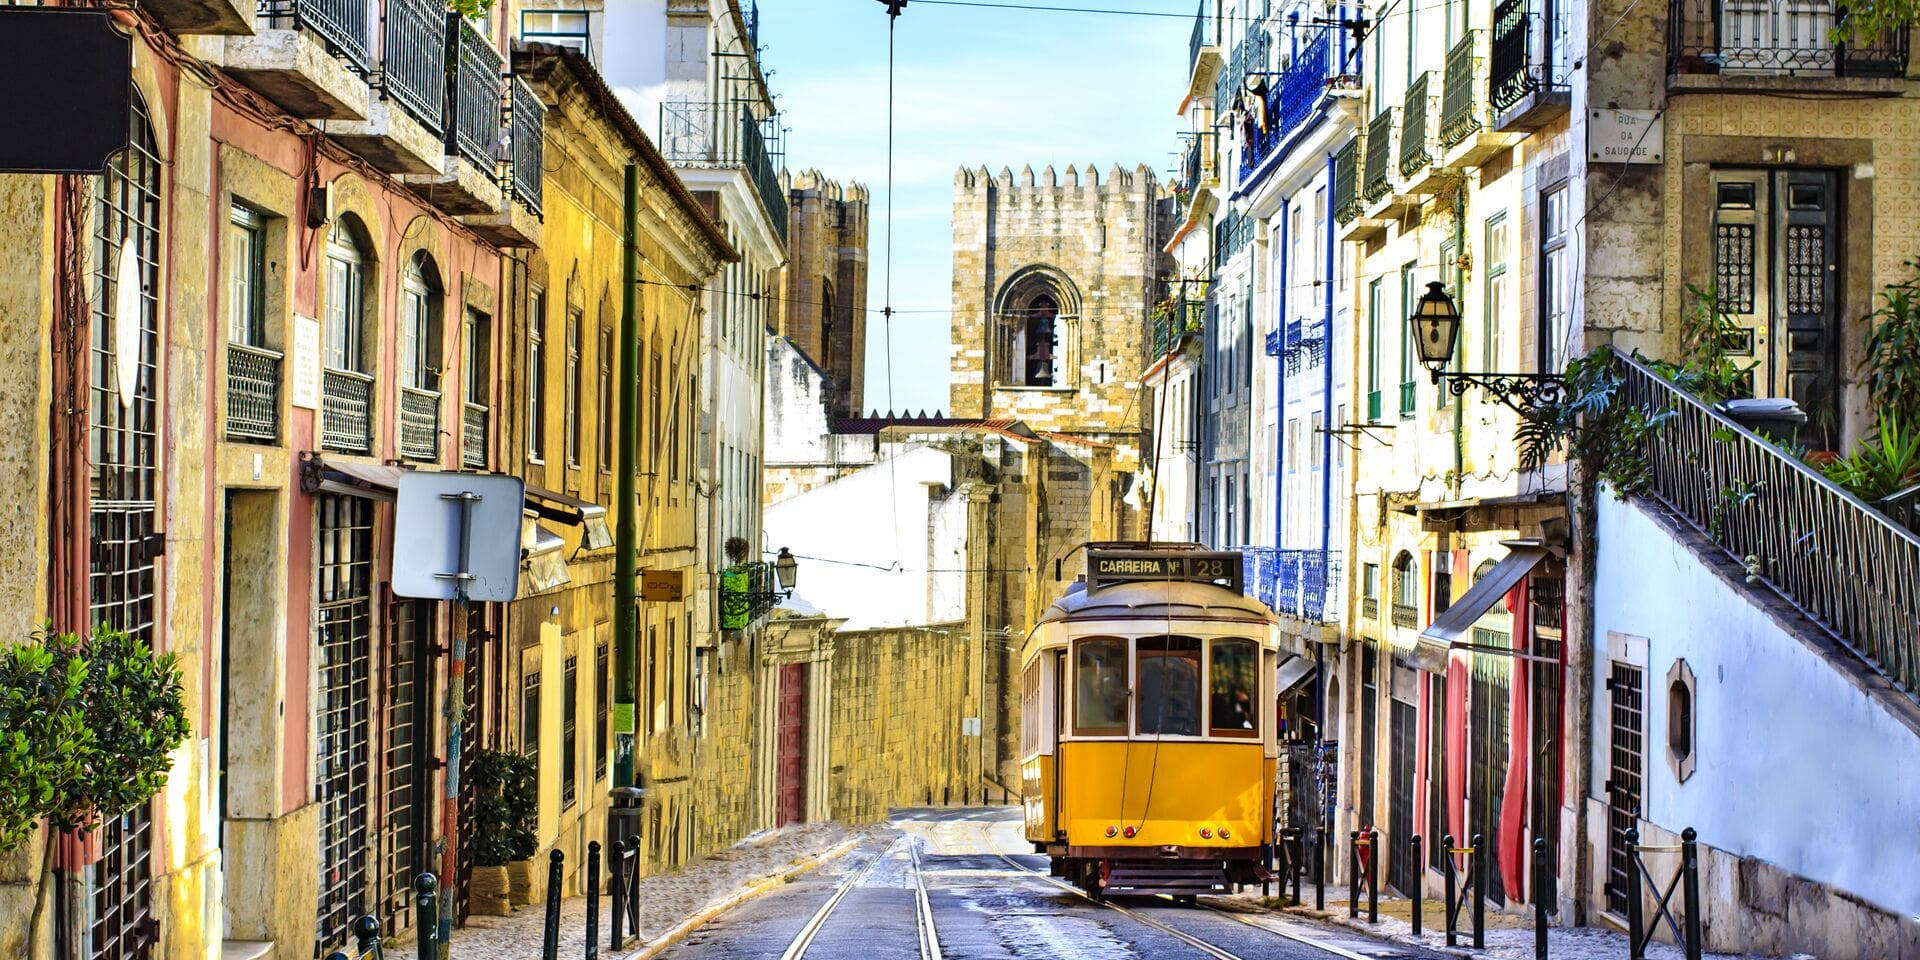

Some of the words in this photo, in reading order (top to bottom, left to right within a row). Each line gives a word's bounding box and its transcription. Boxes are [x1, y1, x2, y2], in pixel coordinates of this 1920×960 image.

[1618, 116, 1636, 125] RUA
[1620, 131, 1633, 140] DA
[1605, 146, 1648, 156] SAUDADE
[1100, 560, 1161, 573] CARREIRA
[1197, 560, 1223, 576] 28
